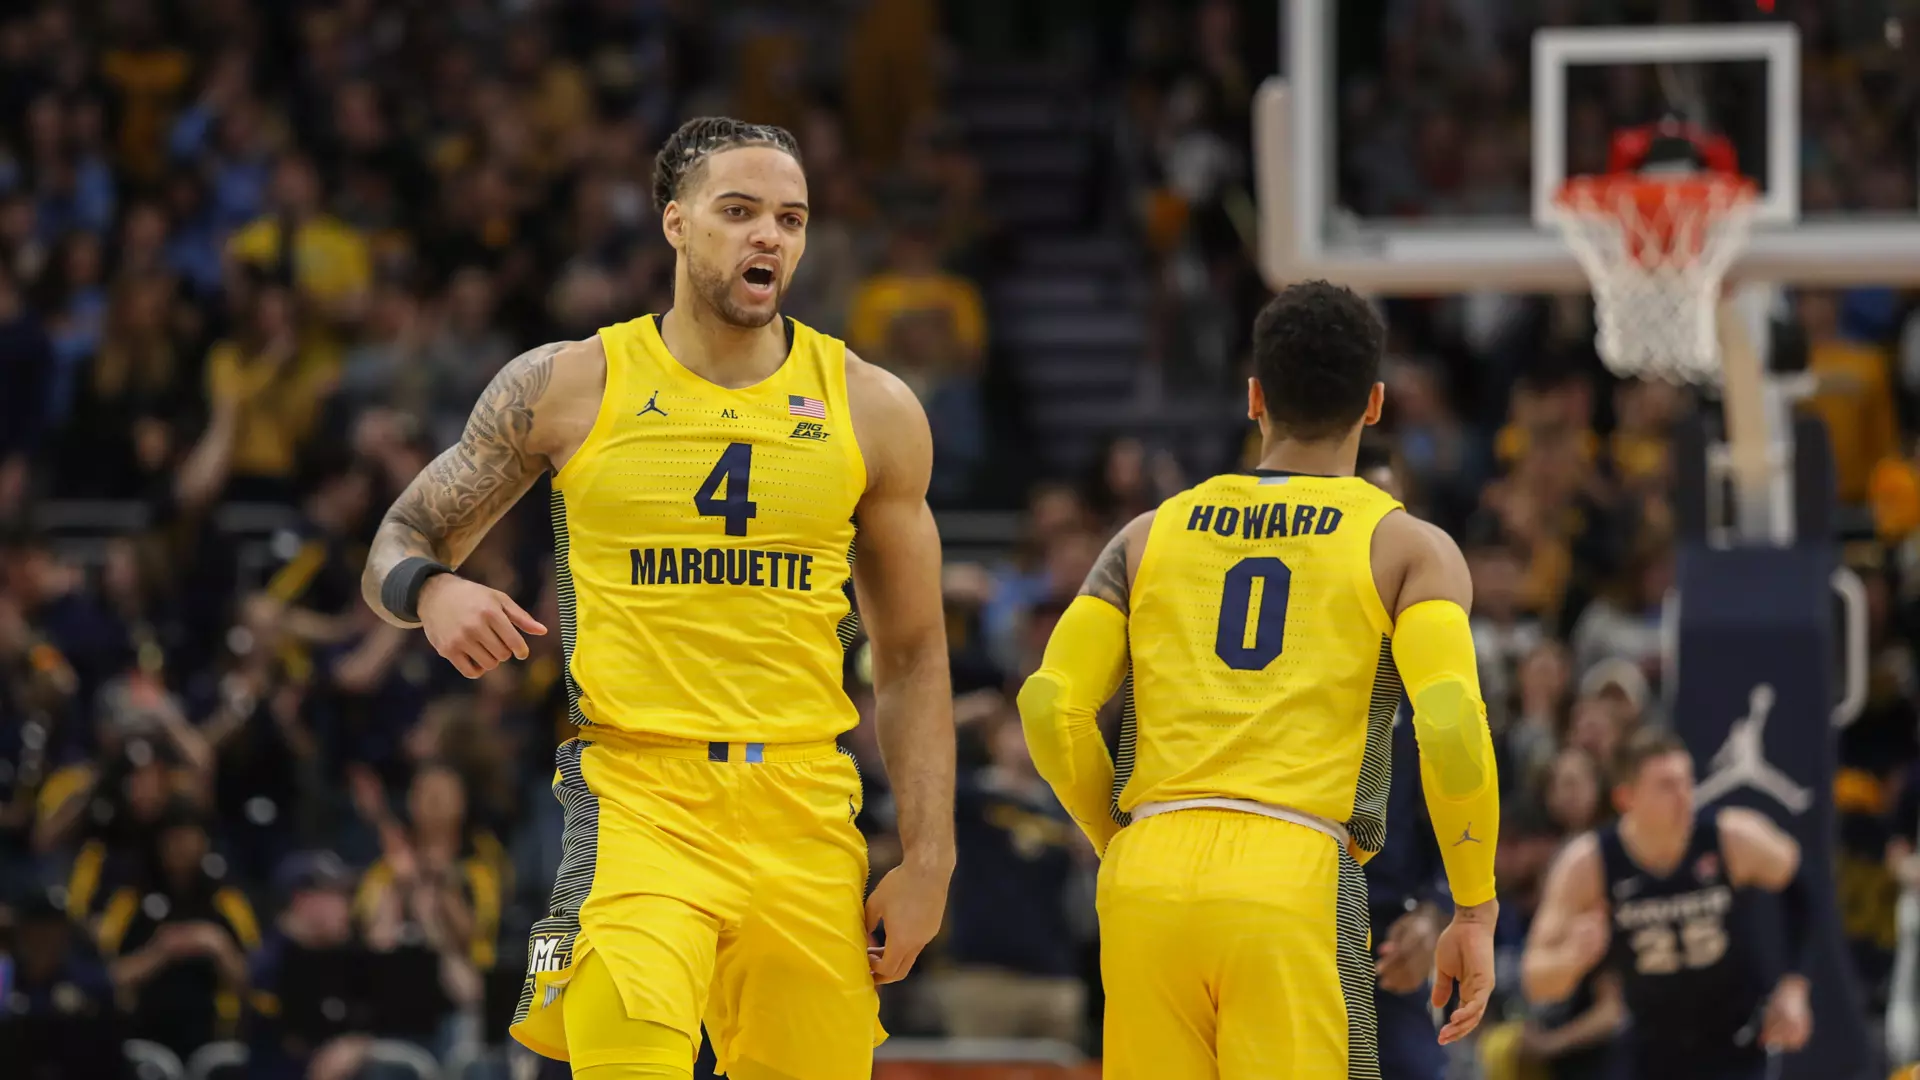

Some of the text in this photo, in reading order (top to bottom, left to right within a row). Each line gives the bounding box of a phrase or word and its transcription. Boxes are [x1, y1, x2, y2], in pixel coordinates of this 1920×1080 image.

[721, 408, 738, 419] AL
[791, 428, 831, 439] EAST
[796, 421, 824, 432] BIG
[693, 442, 757, 537] 4
[1186, 502, 1344, 540] HOWARD
[629, 547, 814, 591] MARQUETTE
[1214, 556, 1292, 671] 0
[1631, 920, 1730, 975] 25
